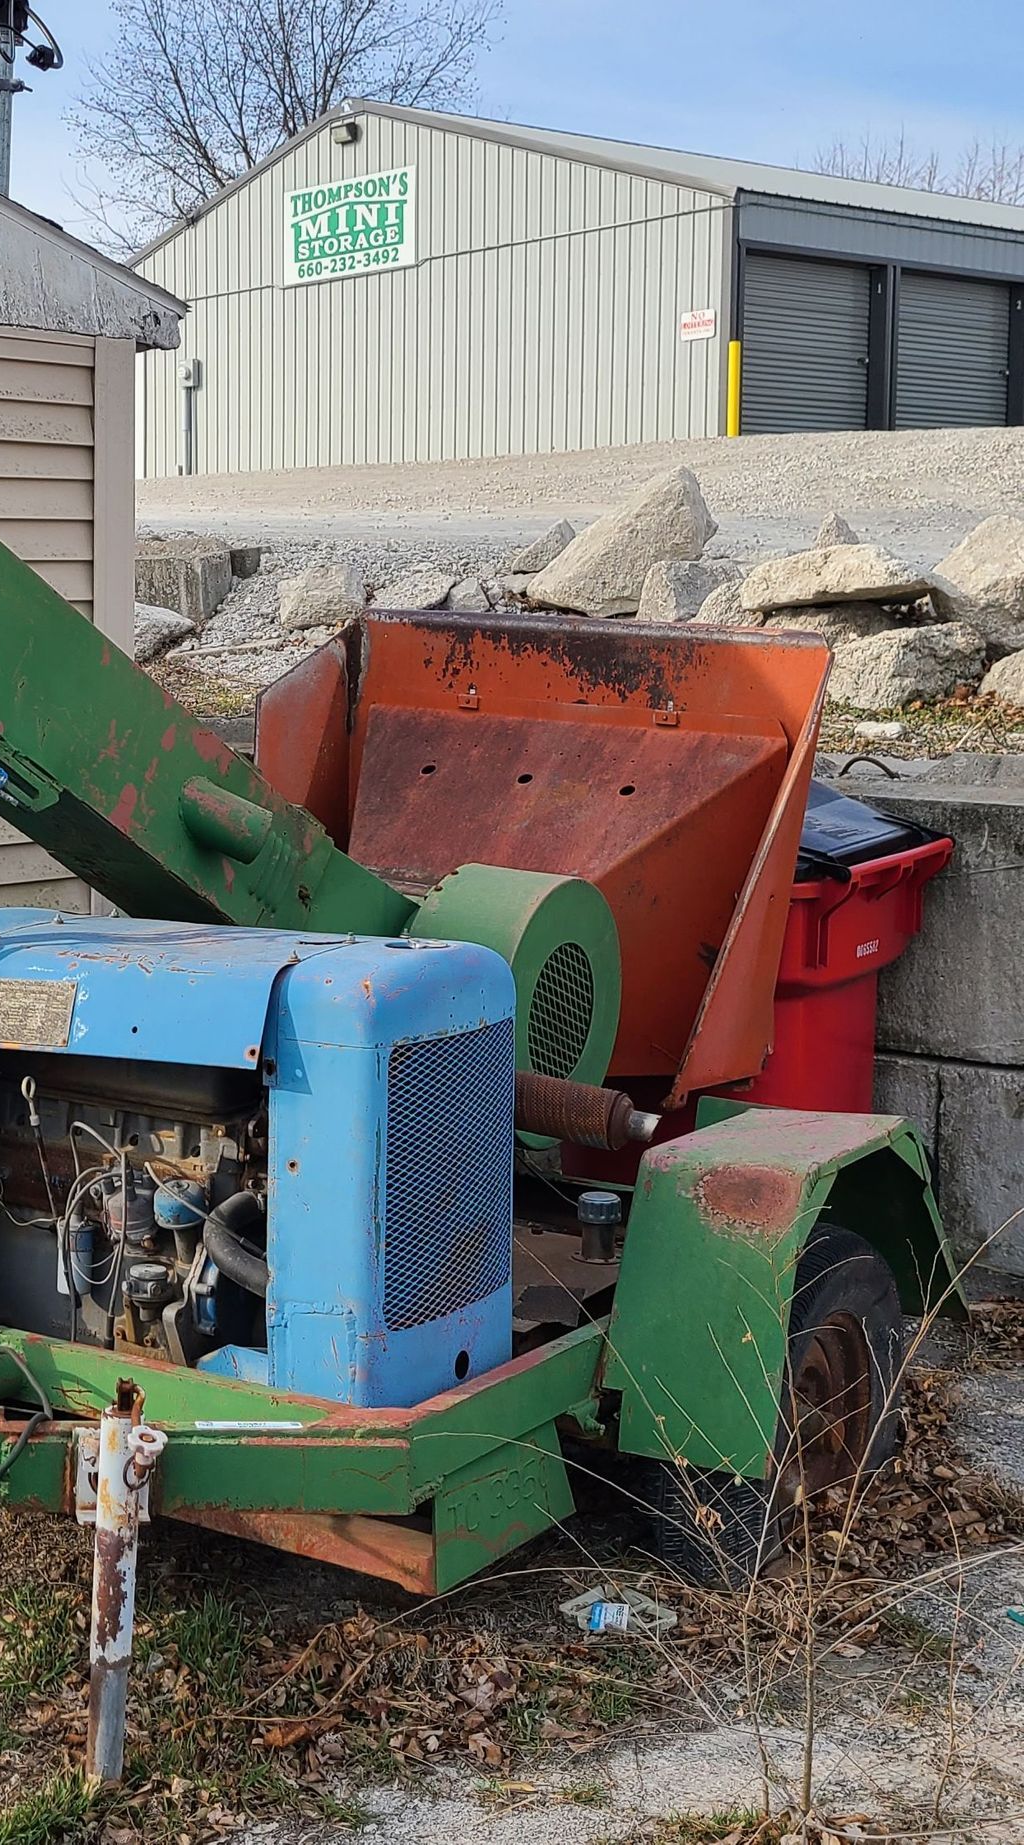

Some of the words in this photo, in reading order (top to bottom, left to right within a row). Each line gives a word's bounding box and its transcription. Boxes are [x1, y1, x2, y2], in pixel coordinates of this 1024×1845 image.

[290, 171, 408, 218] THOMPSON'S
[297, 202, 400, 242] MINI
[297, 226, 400, 260] STORAGE
[297, 247, 400, 279] 660-232-3492
